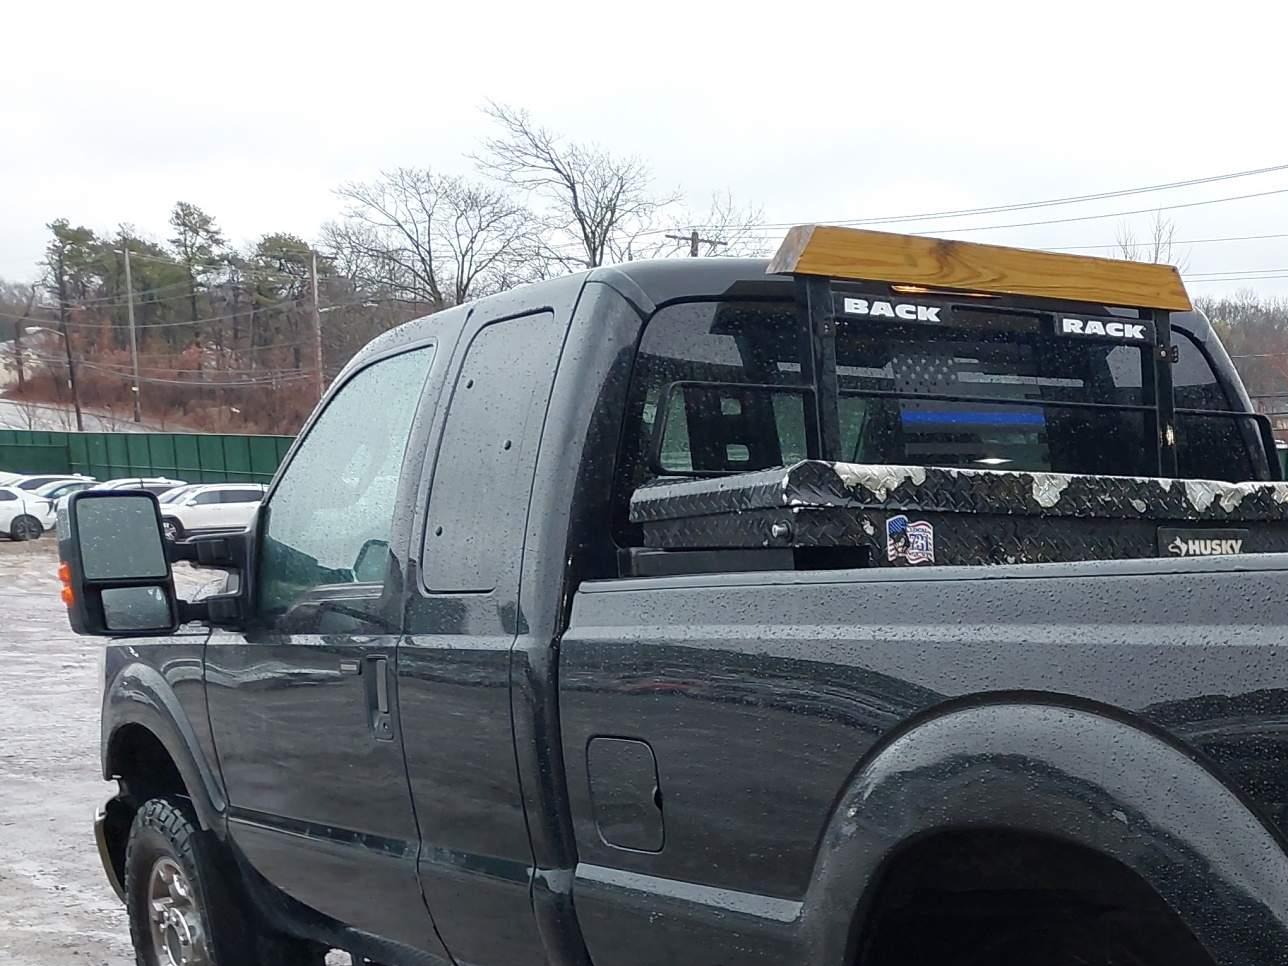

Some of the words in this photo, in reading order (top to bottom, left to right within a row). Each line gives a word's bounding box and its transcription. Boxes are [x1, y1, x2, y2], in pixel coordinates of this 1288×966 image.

[843, 297, 942, 323] BACK
[1062, 317, 1147, 340] RACK
[1187, 539, 1243, 555] HUSKY
